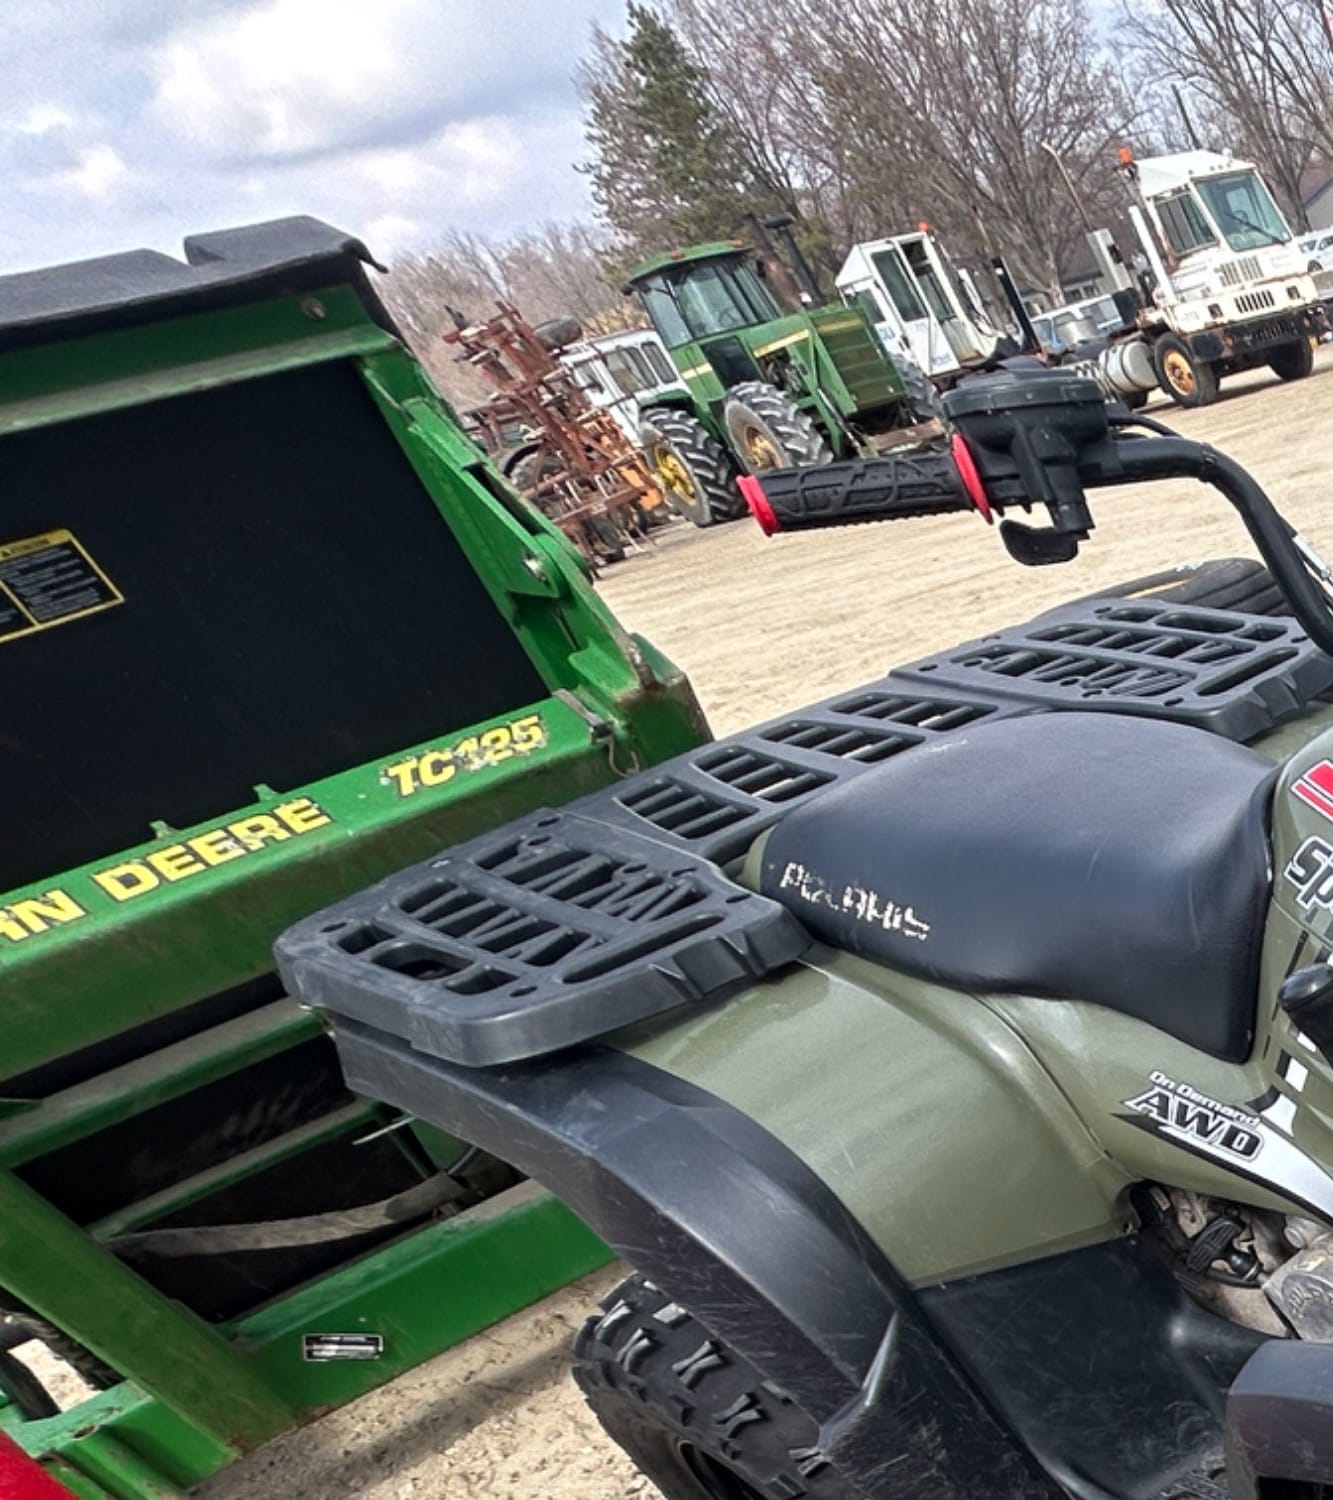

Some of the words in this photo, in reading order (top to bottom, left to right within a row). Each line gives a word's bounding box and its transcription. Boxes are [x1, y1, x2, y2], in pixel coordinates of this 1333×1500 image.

[89, 796, 333, 903] DEERE
[1124, 1086, 1265, 1162] AWD
[1149, 1070, 1176, 1089] On
[1176, 1083, 1260, 1125] Demand
